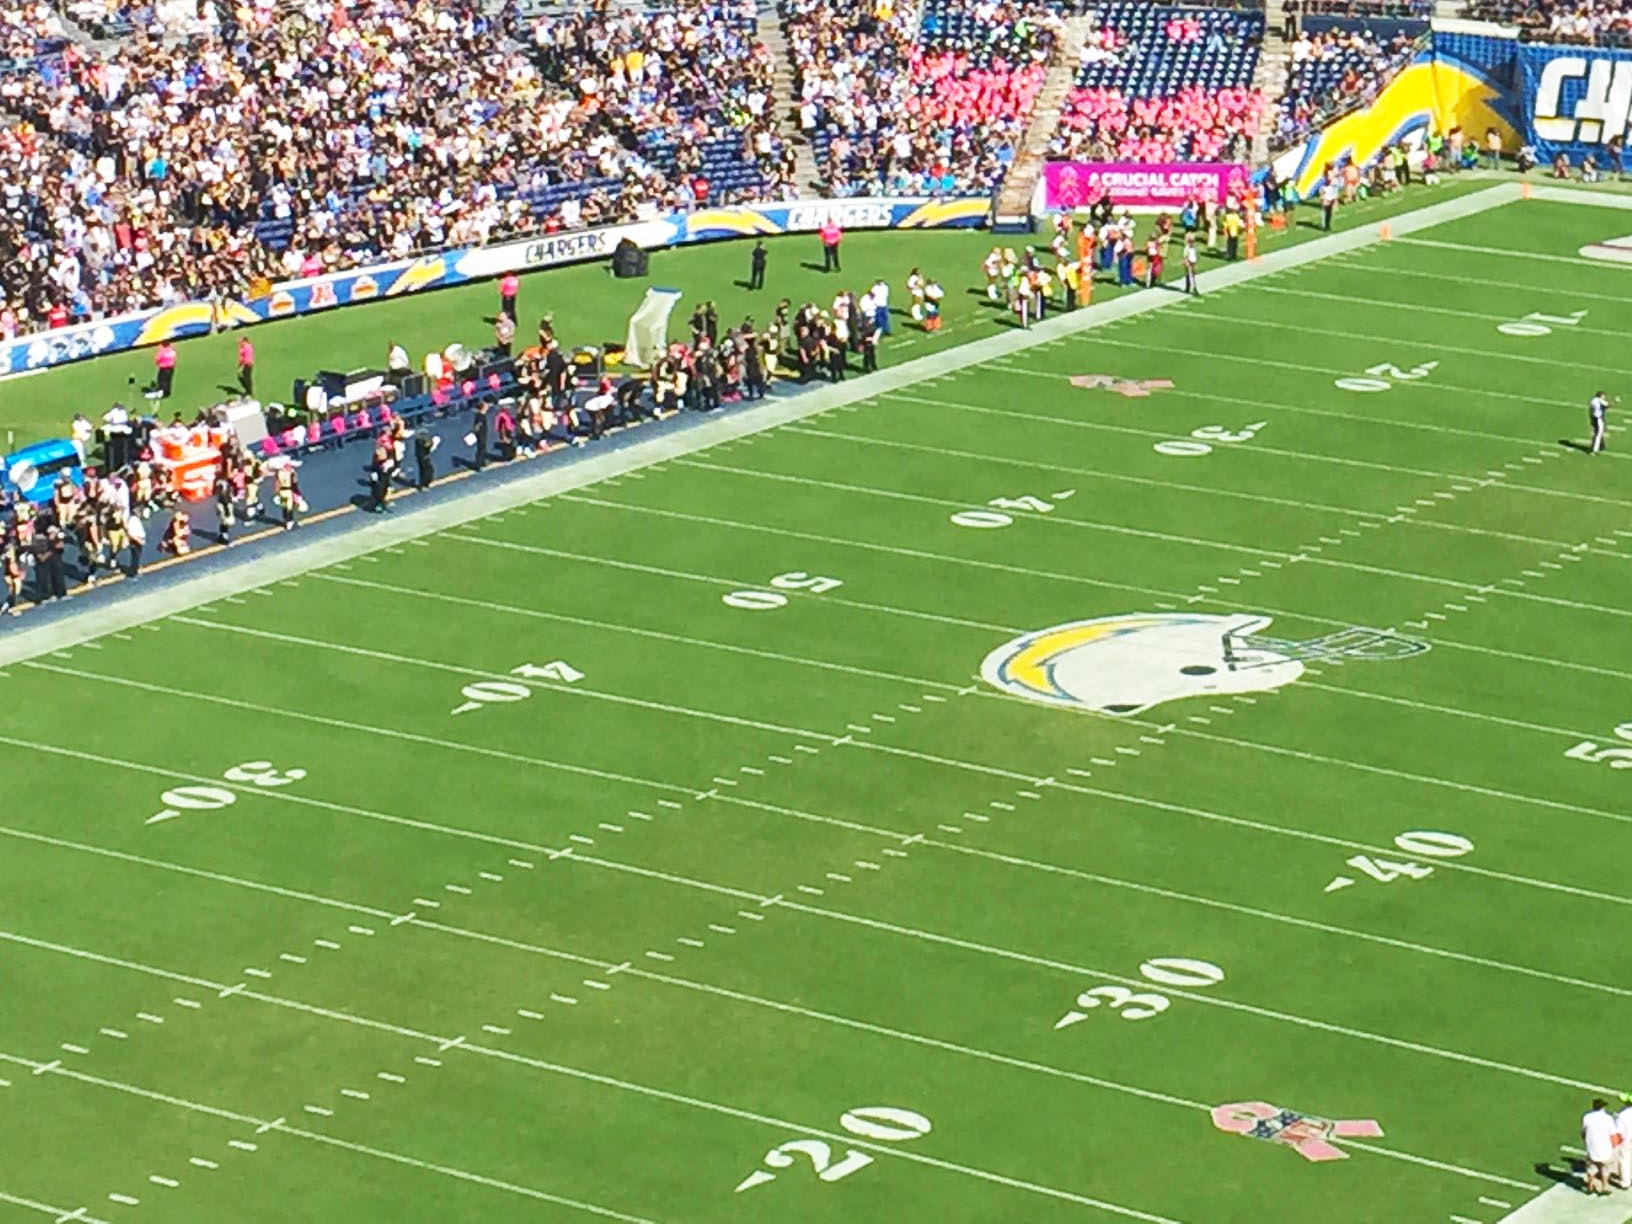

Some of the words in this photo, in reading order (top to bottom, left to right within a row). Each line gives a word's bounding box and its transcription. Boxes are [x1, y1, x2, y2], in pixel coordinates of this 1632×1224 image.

[1101, 172, 1168, 187] CRUCIAL
[1169, 172, 1219, 187] CATCH
[786, 201, 894, 230] CHARGERS
[524, 230, 609, 265] CHARGERS
[1334, 363, 1427, 393] 20
[1153, 424, 1253, 456] 30
[949, 494, 1058, 528] 40
[722, 571, 844, 611] 50
[460, 660, 586, 703] 40
[160, 760, 308, 811] 30
[1344, 829, 1476, 884] 40
[1076, 956, 1226, 1021] 30
[764, 1105, 932, 1183] 20
